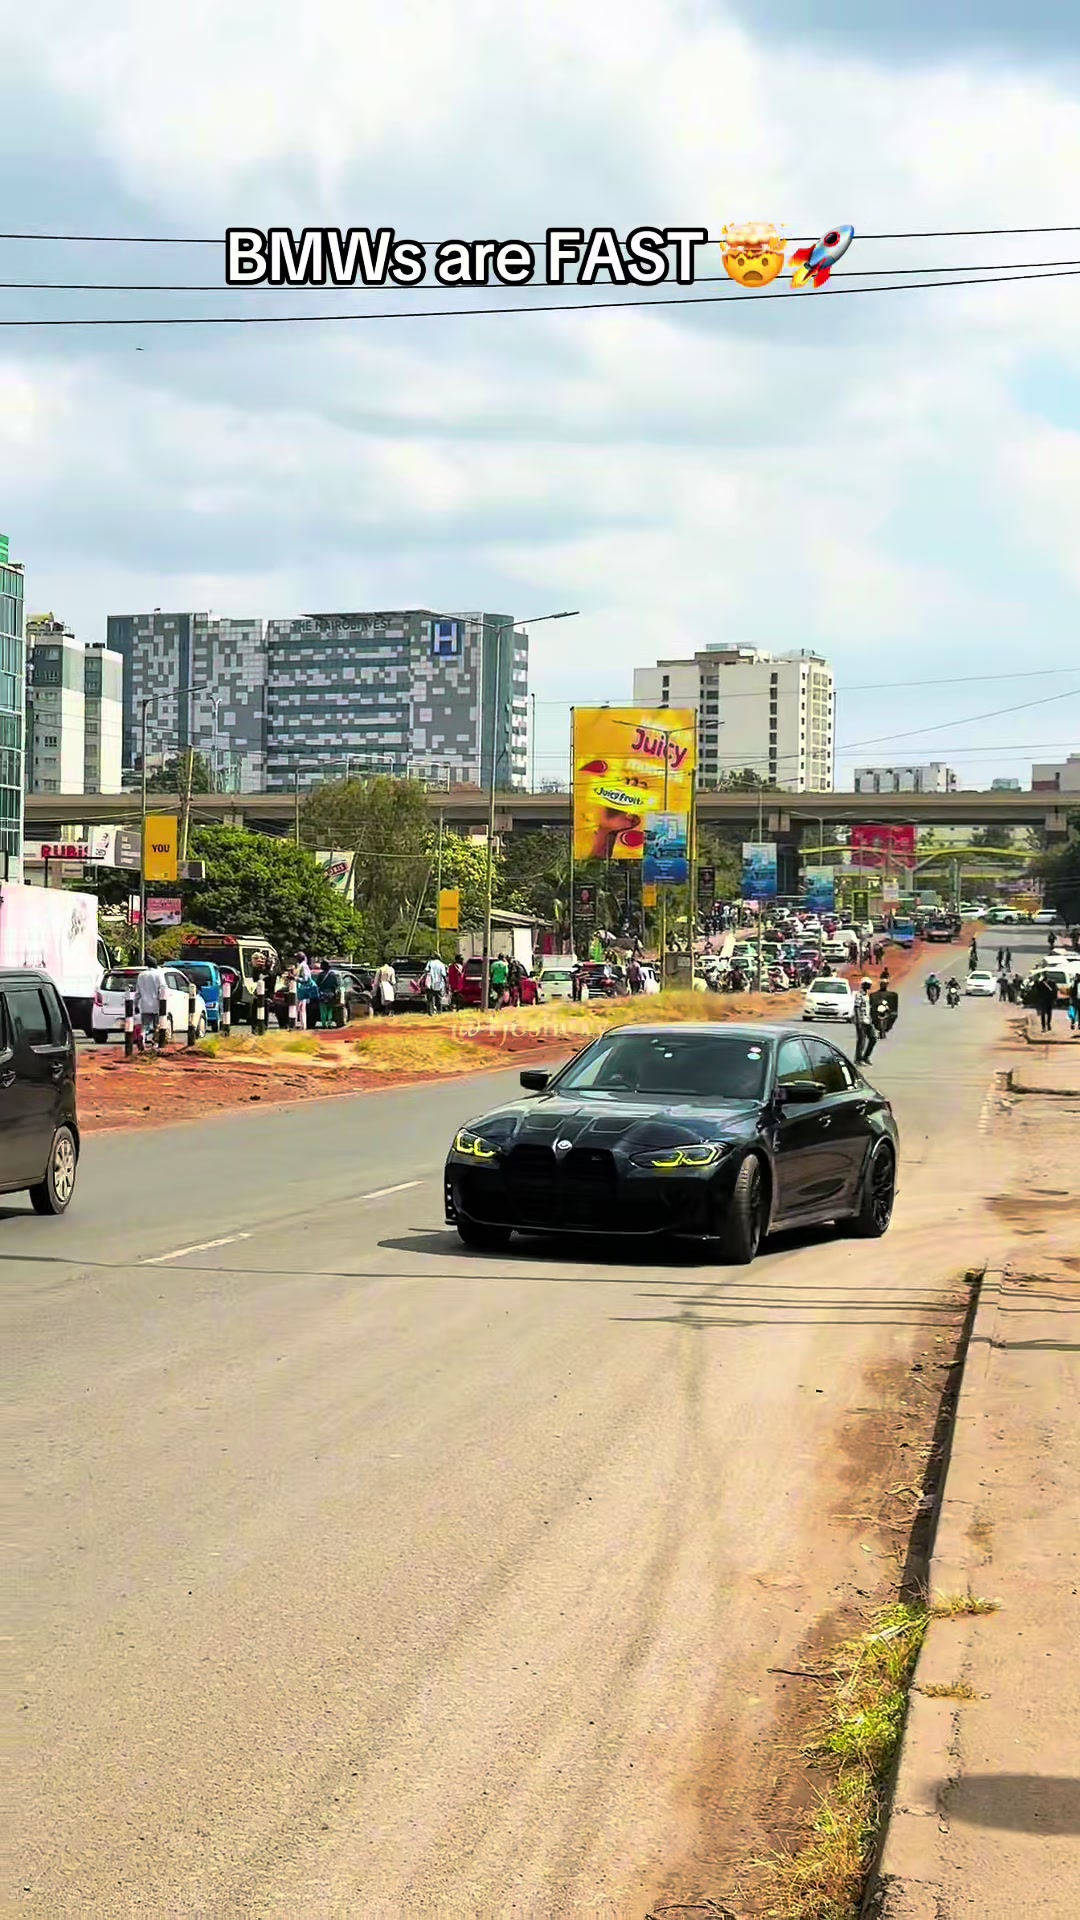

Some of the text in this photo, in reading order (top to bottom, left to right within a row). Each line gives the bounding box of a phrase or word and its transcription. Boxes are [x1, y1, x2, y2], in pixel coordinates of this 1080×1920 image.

[362, 618, 393, 631] WEST
[434, 623, 457, 652] H
[631, 728, 688, 768] Juicy
[152, 844, 170, 853] YOU
